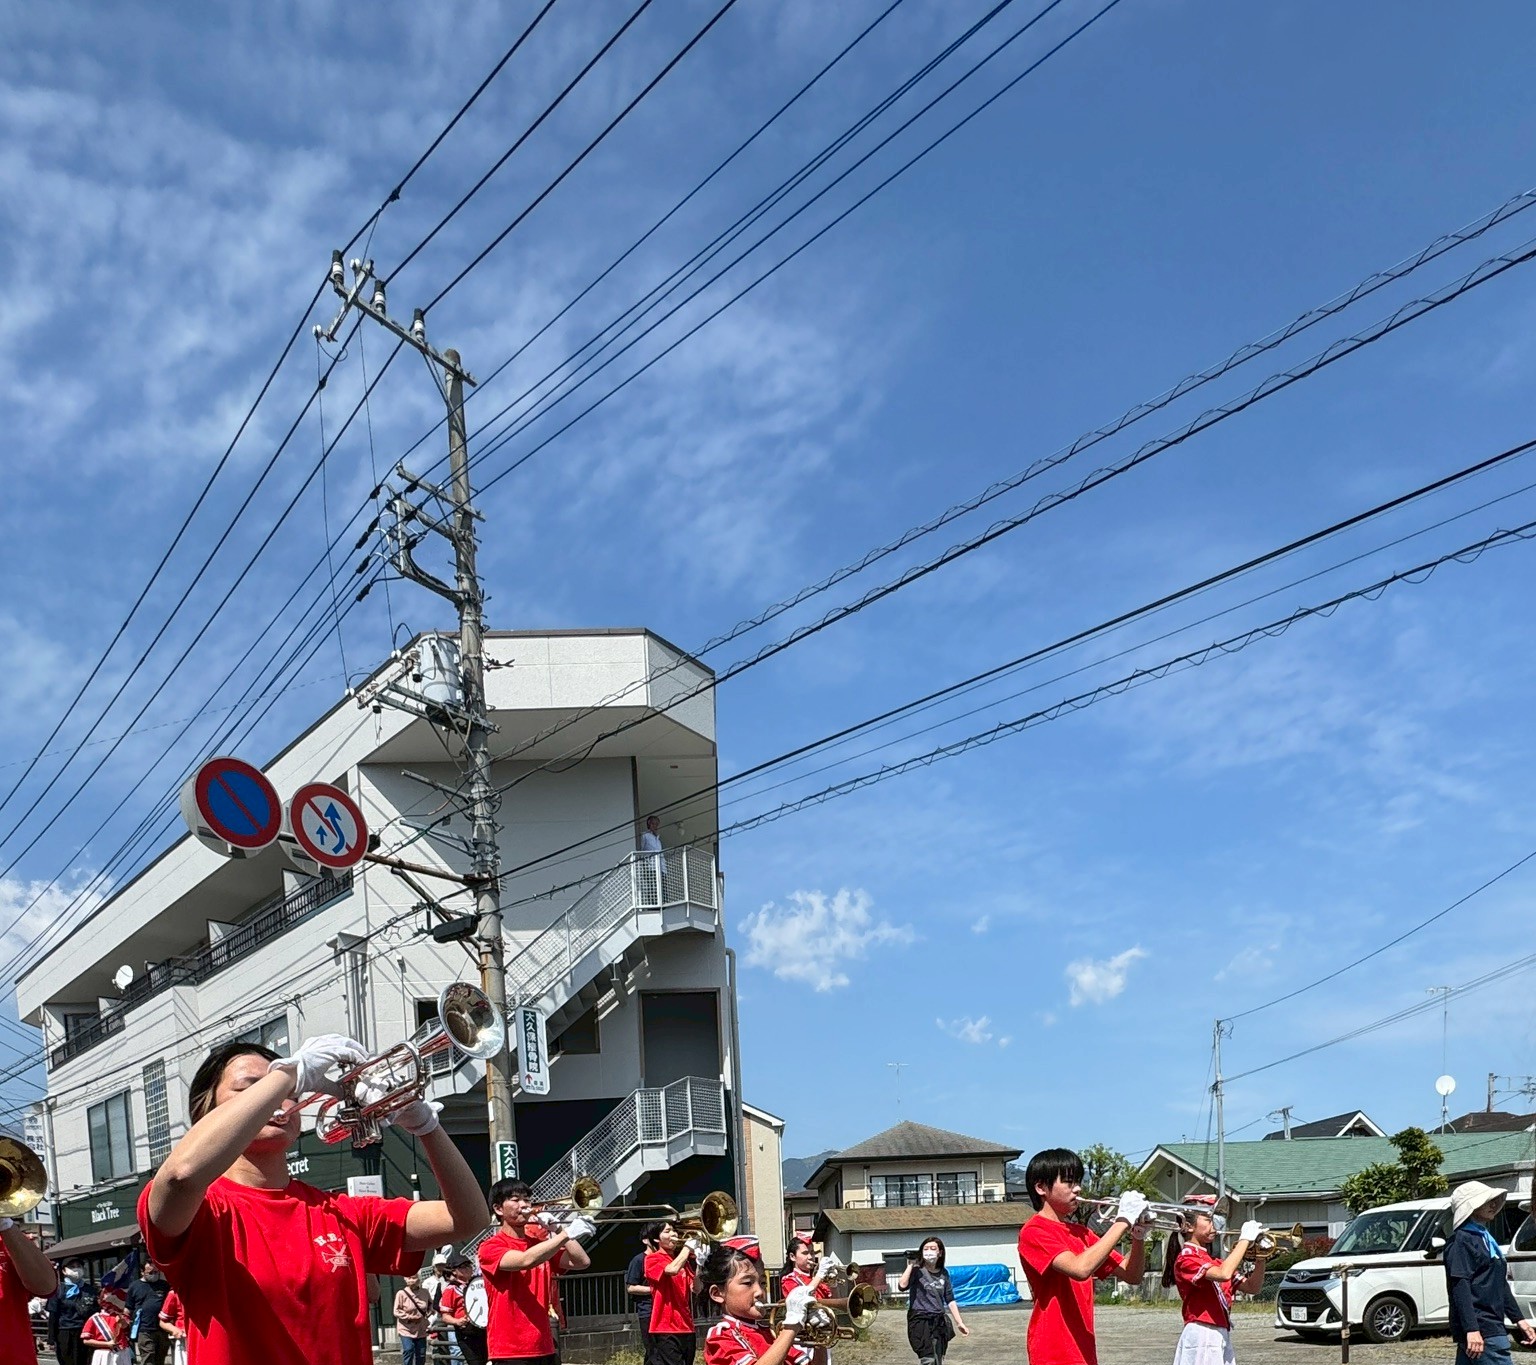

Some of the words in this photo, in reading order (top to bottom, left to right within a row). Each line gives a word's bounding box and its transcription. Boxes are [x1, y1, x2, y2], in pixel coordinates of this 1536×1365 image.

[287, 1156, 309, 1176] ecret
[91, 1208, 106, 1223] Black
[106, 1207, 120, 1219] Tree
